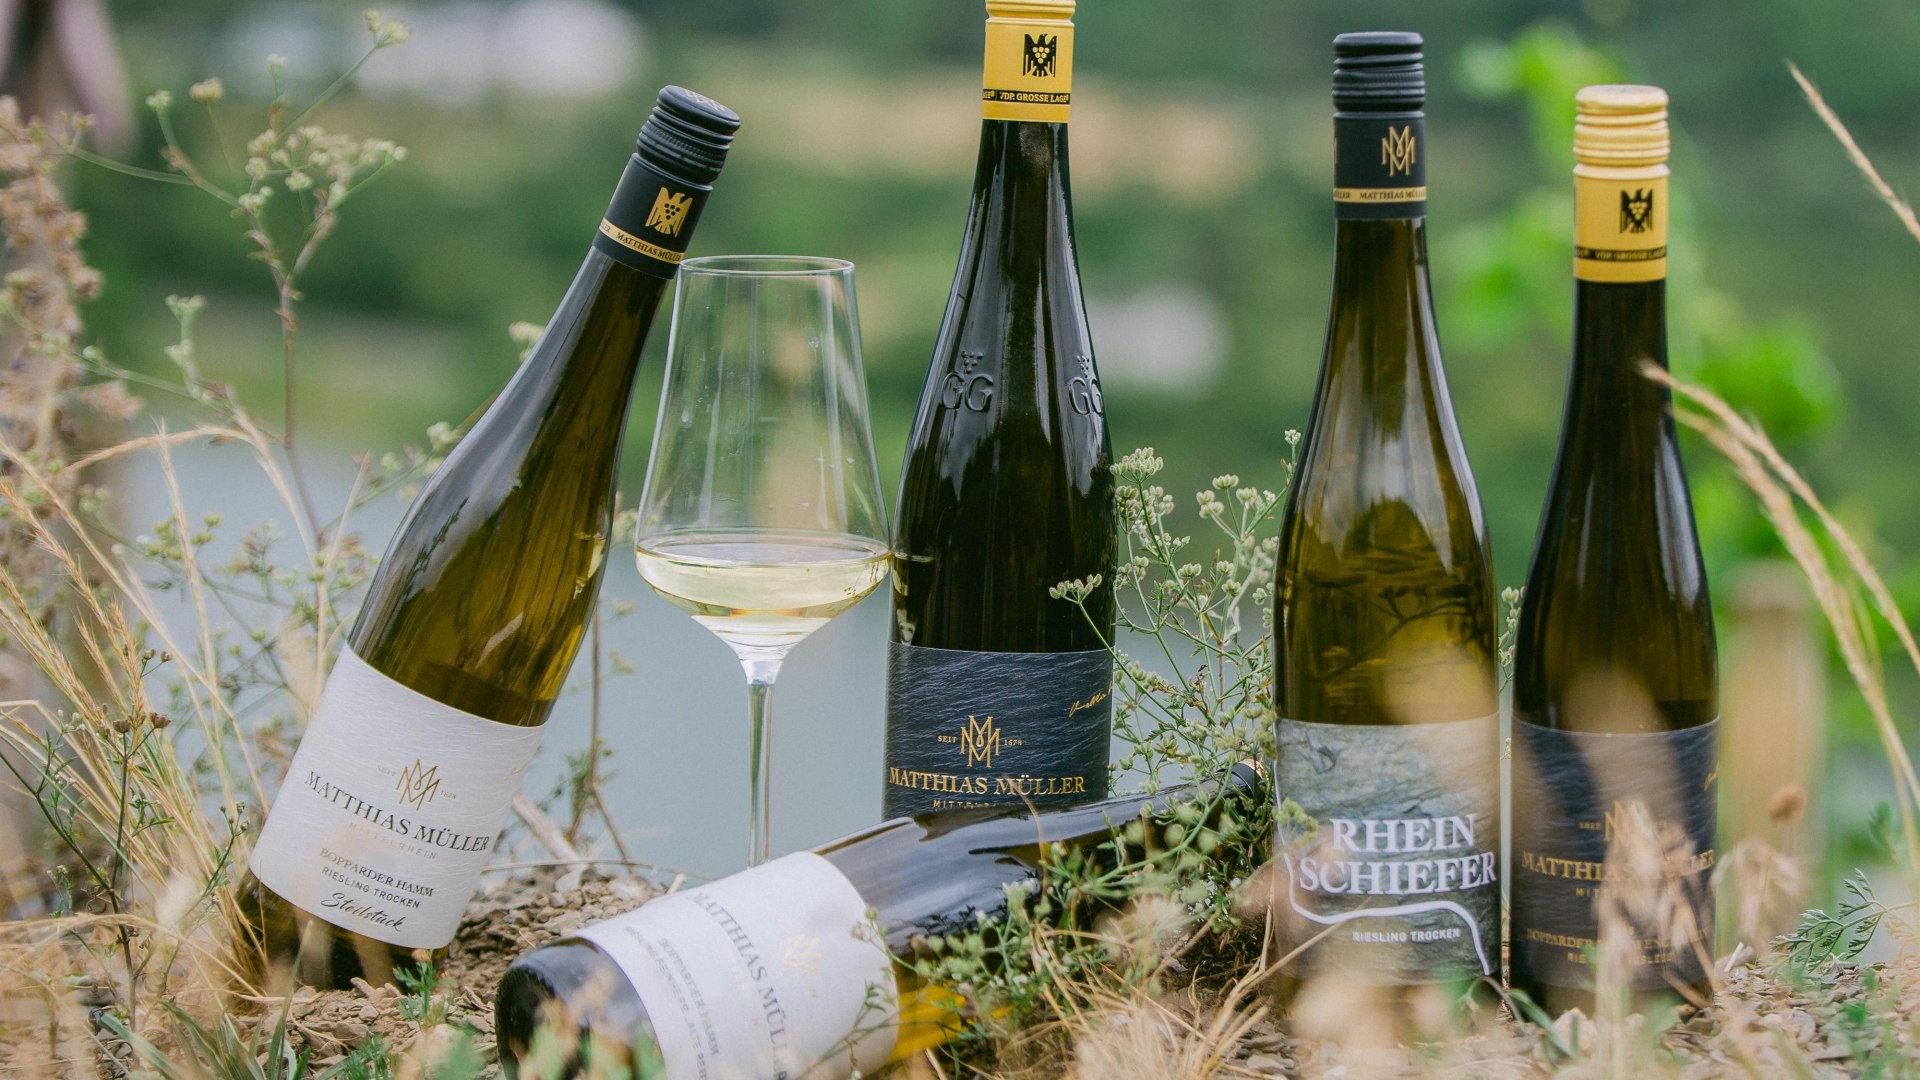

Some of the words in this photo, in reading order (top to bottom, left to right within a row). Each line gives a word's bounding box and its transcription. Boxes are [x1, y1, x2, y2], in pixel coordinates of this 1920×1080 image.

[1016, 93, 1049, 102] GROSSE
[1360, 191, 1404, 199] MATTHIAS
[616, 232, 658, 255] MATTHIAS
[937, 734, 958, 744] SEIT
[889, 766, 989, 796] MATTHIAS
[993, 773, 1087, 797] MÜLLER
[304, 770, 412, 836] MATTHIAS
[413, 824, 491, 853] MÜLLER
[1329, 812, 1478, 852] RHEIN
[320, 847, 396, 887] BOPPARDER
[395, 879, 435, 898] HAMM
[321, 866, 371, 894] RIESLING
[373, 888, 421, 910] TROCKEN
[1299, 851, 1497, 895] SCHIEFER
[320, 892, 407, 934] Steilstück
[1352, 931, 1407, 943] RIESLING
[1409, 927, 1461, 942] TROCKEN
